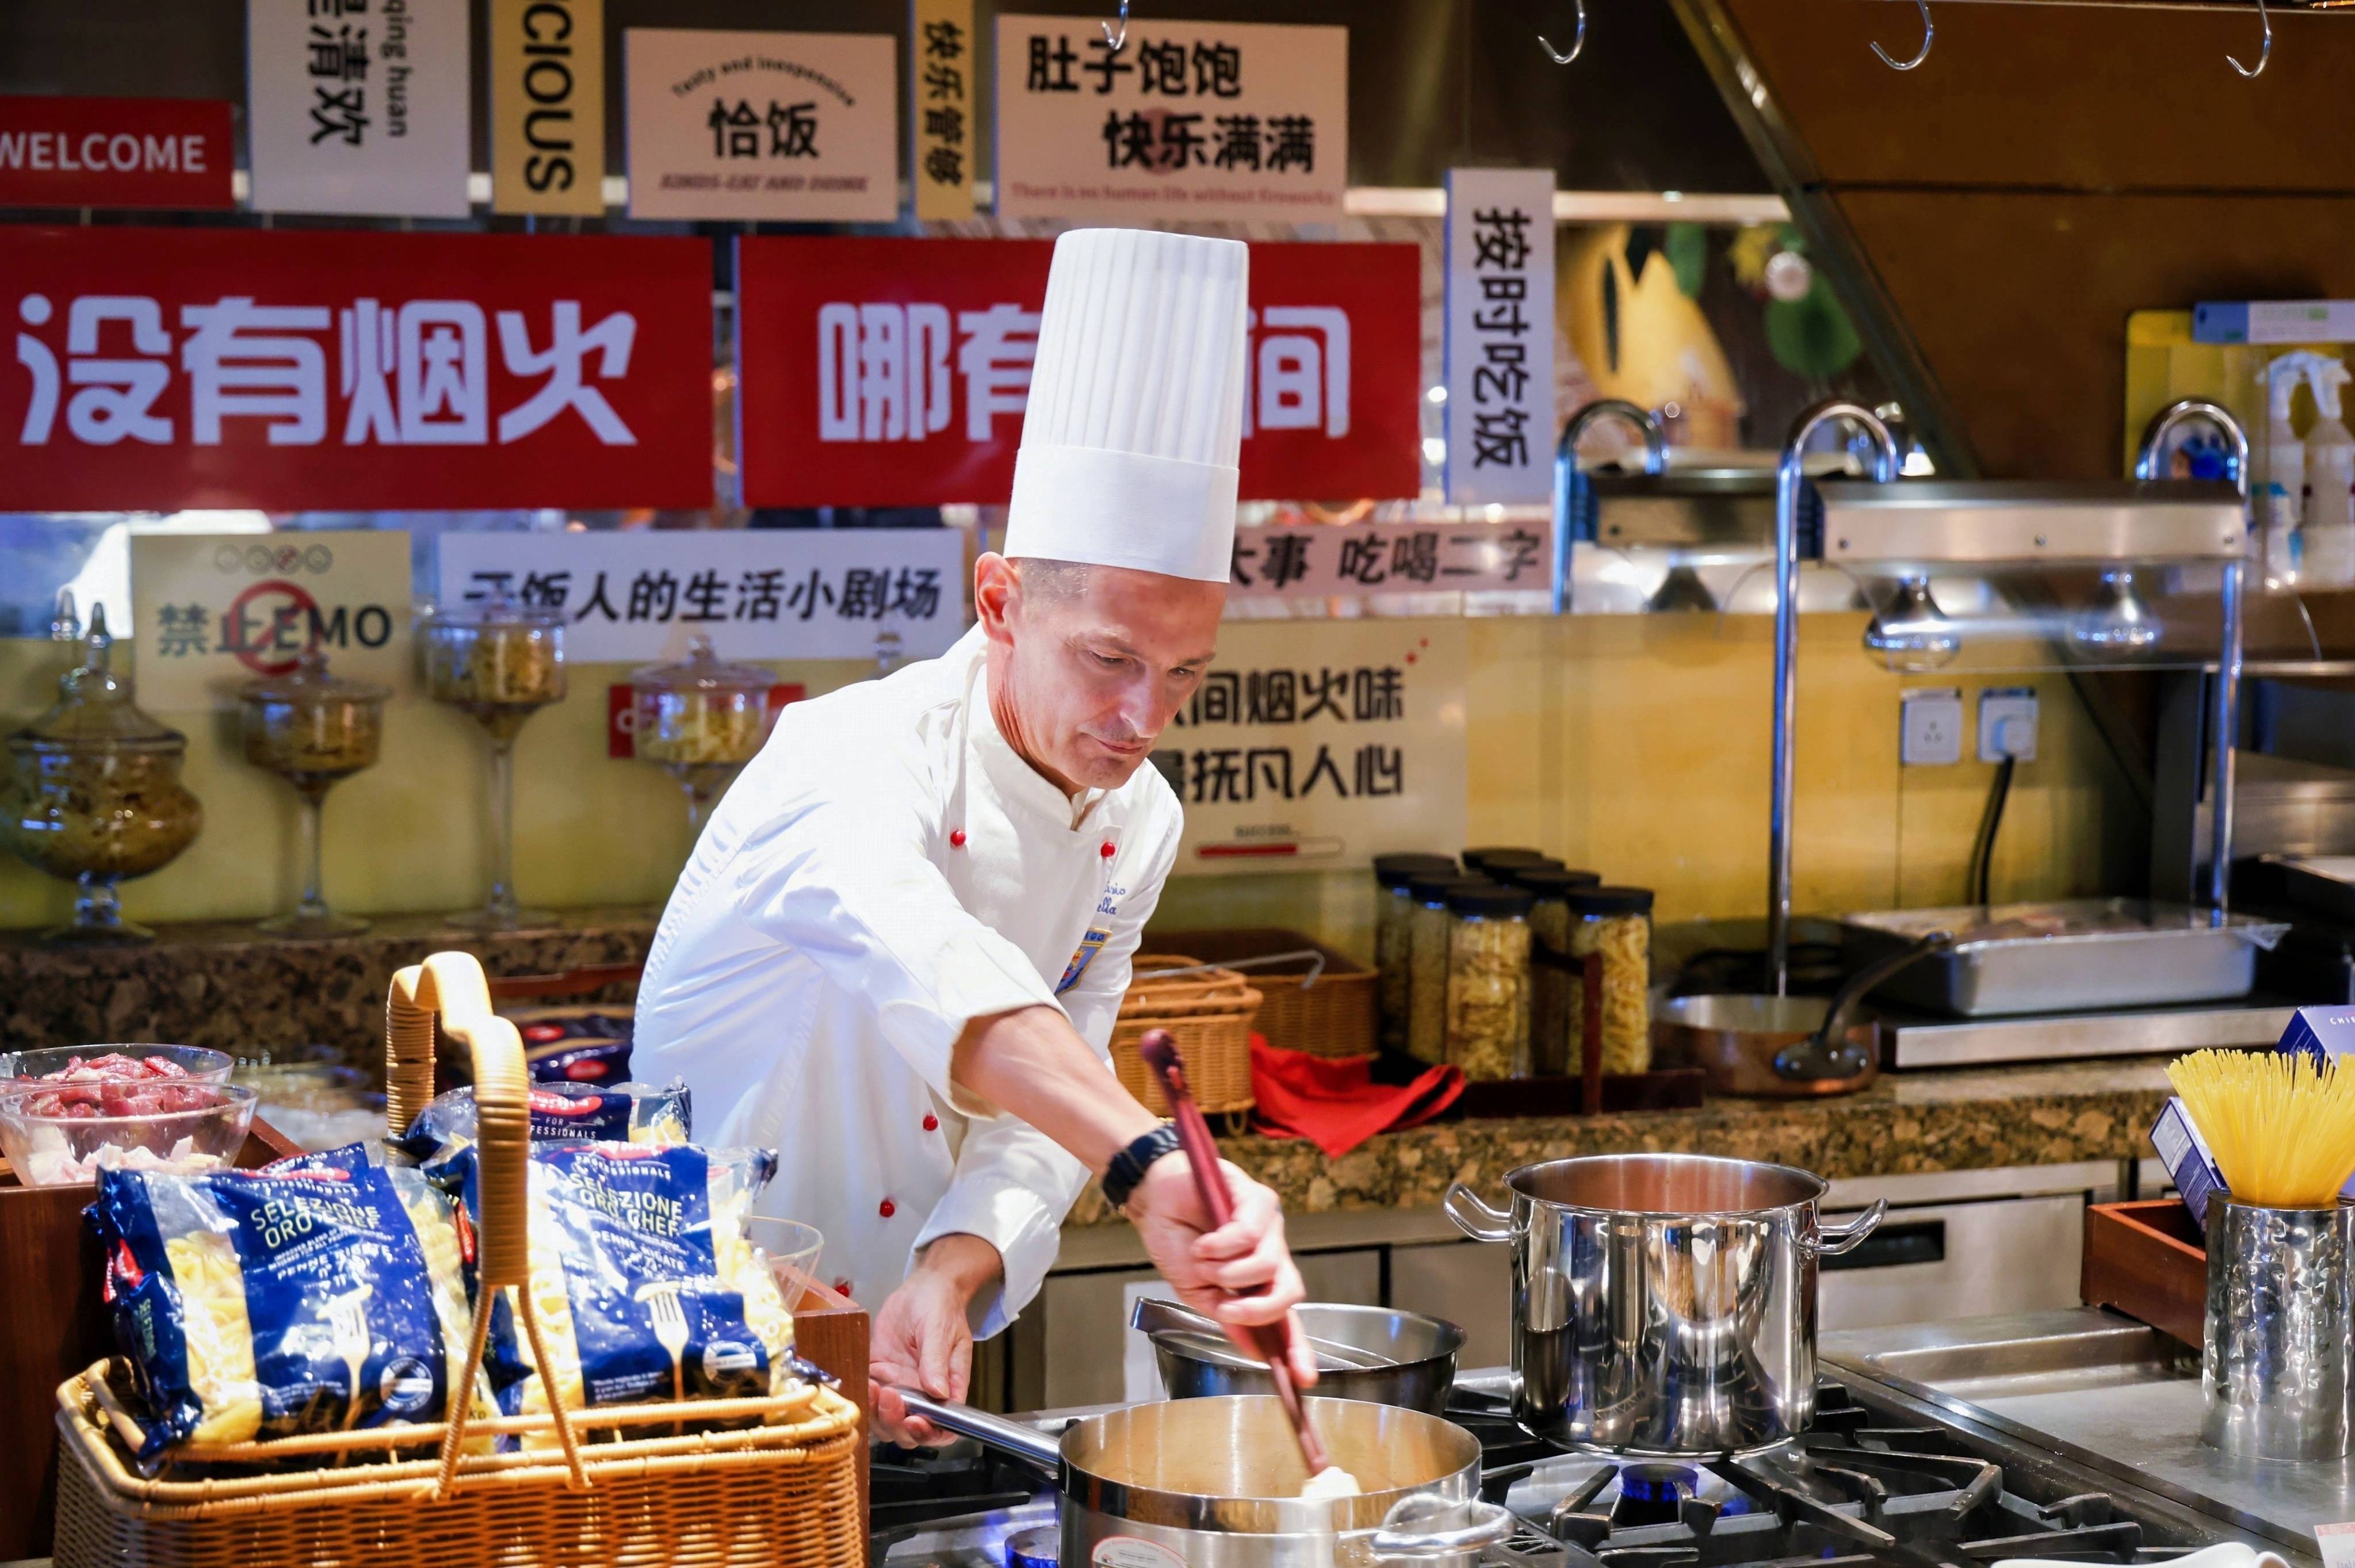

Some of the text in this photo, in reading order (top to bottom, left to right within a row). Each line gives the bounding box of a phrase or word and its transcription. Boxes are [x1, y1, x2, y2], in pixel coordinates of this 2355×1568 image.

[308, 0, 370, 146] 清欢
[721, 56, 753, 75] and
[1026, 33, 1243, 98] 肚子饱饱
[387, 66, 414, 137] huan
[522, 6, 574, 194] CIOUS
[707, 95, 820, 159] 恰饭
[923, 18, 966, 188] 快乐管够
[0, 132, 207, 173] WELCOME
[1102, 108, 1316, 174] 快乐满满
[17, 293, 639, 446] 没有烟火
[1471, 206, 1533, 469] 按时吃饭
[817, 301, 1351, 442] 哪有间
[1337, 528, 1542, 586] 吃喝二字
[1175, 667, 1404, 726] 间烟火味
[530, 1126, 597, 1139] FESSIONALS
[545, 1116, 564, 1126] FOR
[265, 1211, 312, 1249] ORO
[626, 1208, 679, 1238] CHEF
